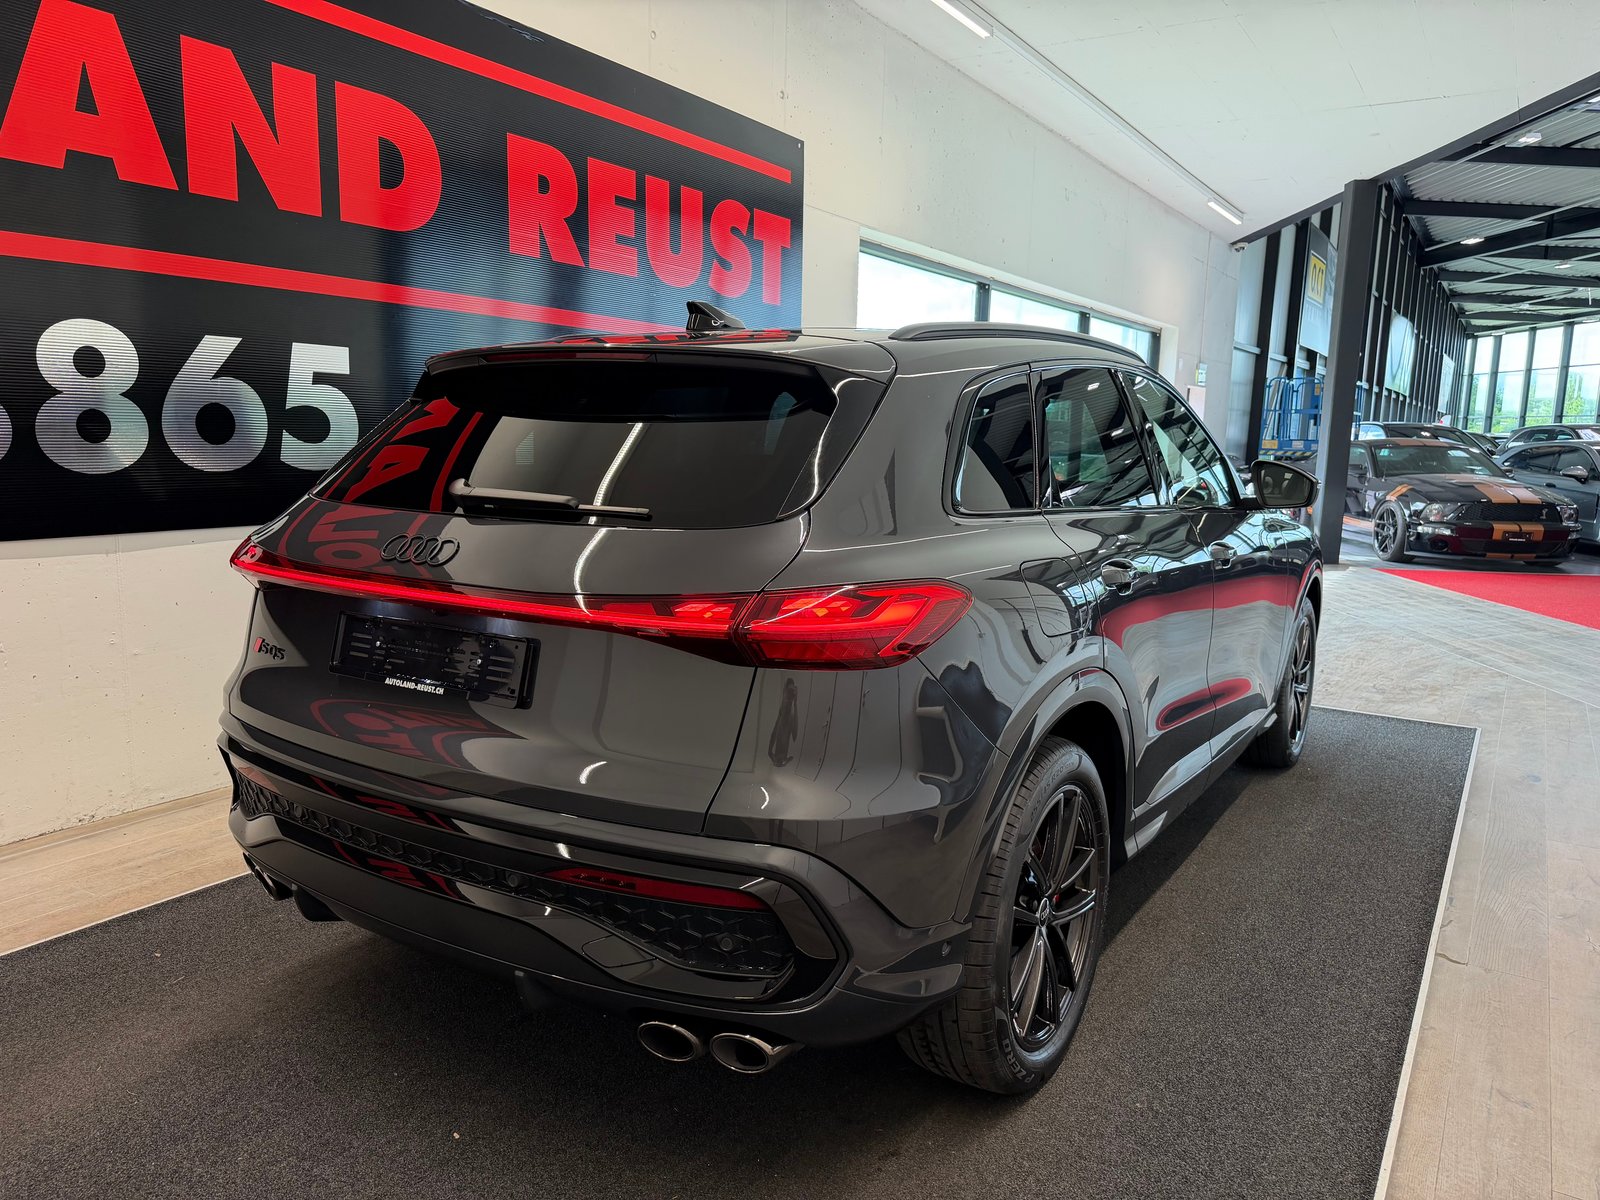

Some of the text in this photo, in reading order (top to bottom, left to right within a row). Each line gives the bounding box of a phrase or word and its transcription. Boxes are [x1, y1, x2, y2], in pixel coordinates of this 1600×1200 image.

[506, 132, 792, 306] REUST
[0, 318, 359, 474] 865
[384, 677, 445, 695] AUTOLAND-REUST.CH
[1002, 1038, 1027, 1080] ZERO
